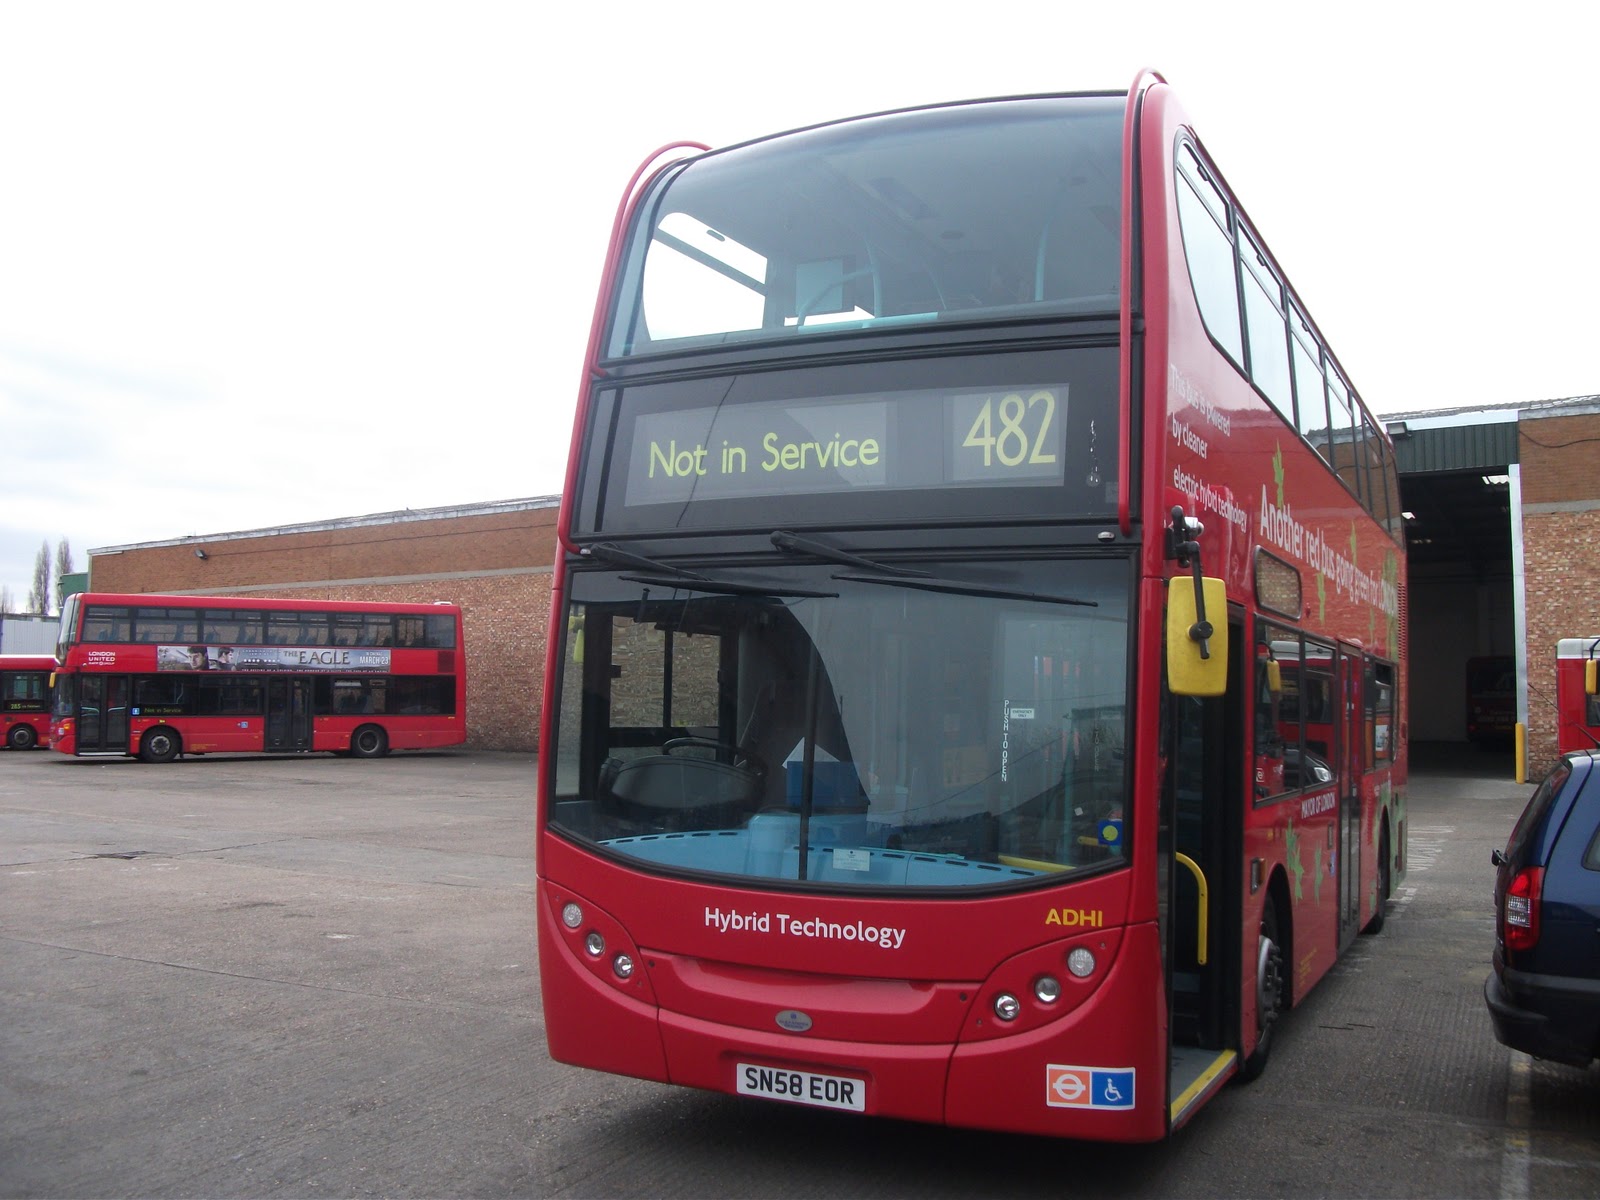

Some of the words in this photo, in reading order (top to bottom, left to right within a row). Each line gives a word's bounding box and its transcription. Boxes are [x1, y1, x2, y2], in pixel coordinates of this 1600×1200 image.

[962, 390, 1056, 466] 482
[1172, 411, 1182, 447] by
[1182, 422, 1208, 460] cleaner
[1206, 400, 1231, 437] powered
[648, 439, 708, 479] Not
[721, 440, 747, 474] in
[761, 432, 879, 472] Service
[1173, 464, 1199, 501] electric
[1199, 478, 1218, 512] hybrid
[1218, 494, 1248, 534] technology
[1260, 483, 1304, 560] Another
[1305, 527, 1320, 571] red
[1321, 529, 1334, 581] bus
[1336, 549, 1354, 602] going
[299, 650, 350, 665] EAGLE
[359, 656, 380, 665] MARCH
[381, 656, 389, 665] 23
[1003, 732, 1009, 749] TO
[1001, 750, 1009, 782] OPEN
[704, 906, 770, 933] Hybrid
[776, 913, 906, 950] Technology
[745, 1067, 803, 1097] SN58
[809, 1076, 854, 1105] EOR
